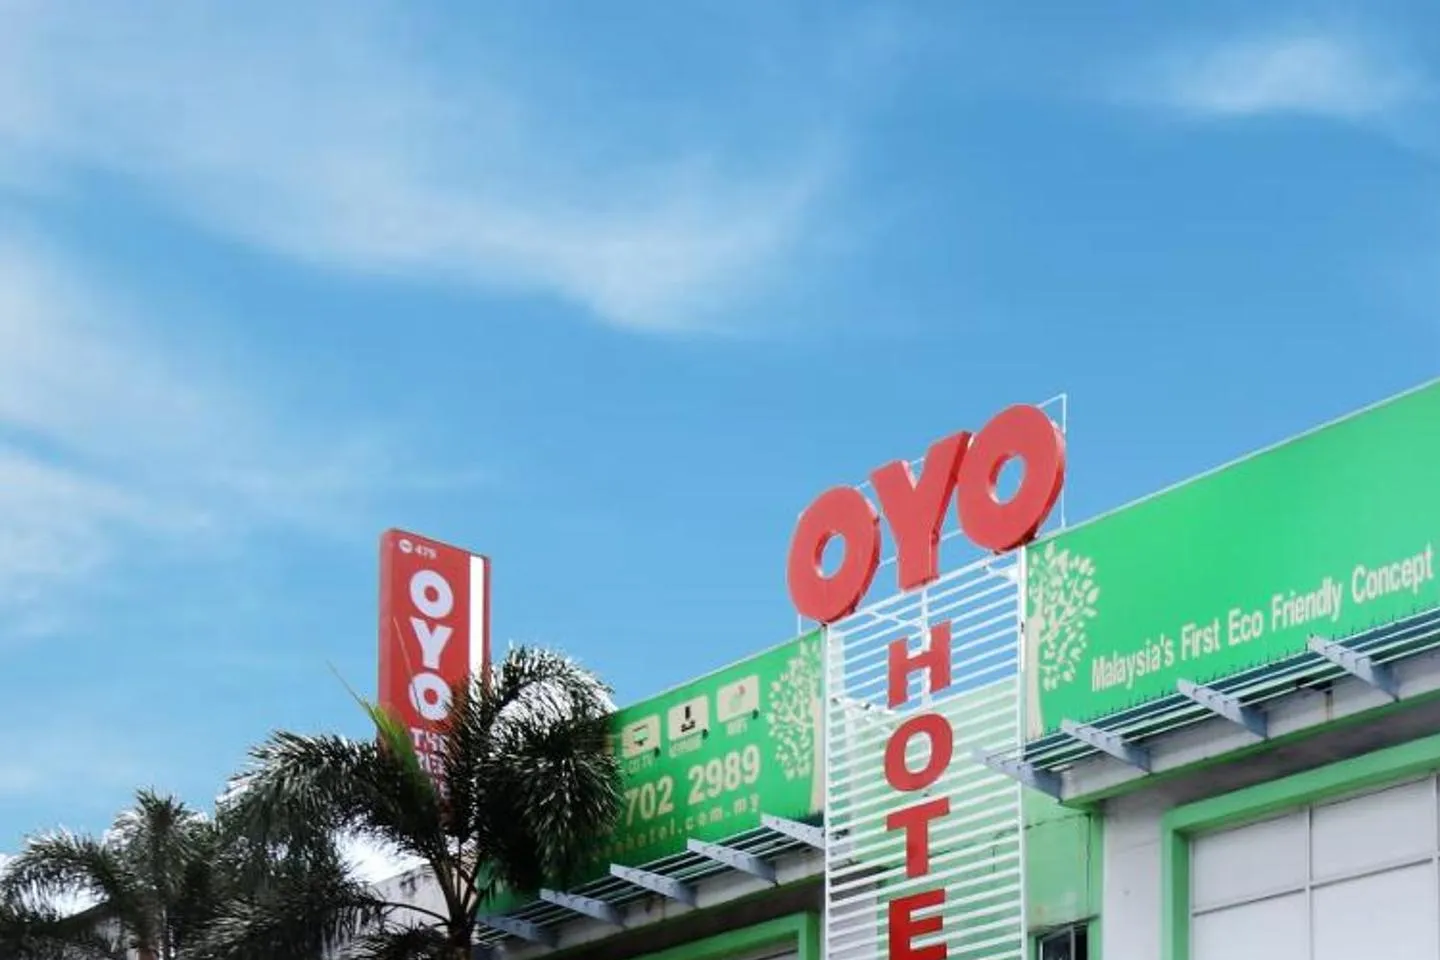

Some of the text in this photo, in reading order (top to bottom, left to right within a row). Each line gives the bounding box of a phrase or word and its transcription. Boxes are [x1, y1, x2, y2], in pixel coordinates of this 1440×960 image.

[786, 403, 1066, 625] OYO
[409, 569, 454, 720] OYO
[1092, 633, 1174, 692] Malaysia's
[1181, 616, 1221, 661] First
[1227, 607, 1264, 646] Eco
[1271, 575, 1342, 632] Friendly
[1352, 543, 1434, 604] Concept
[688, 744, 761, 806] 2989
